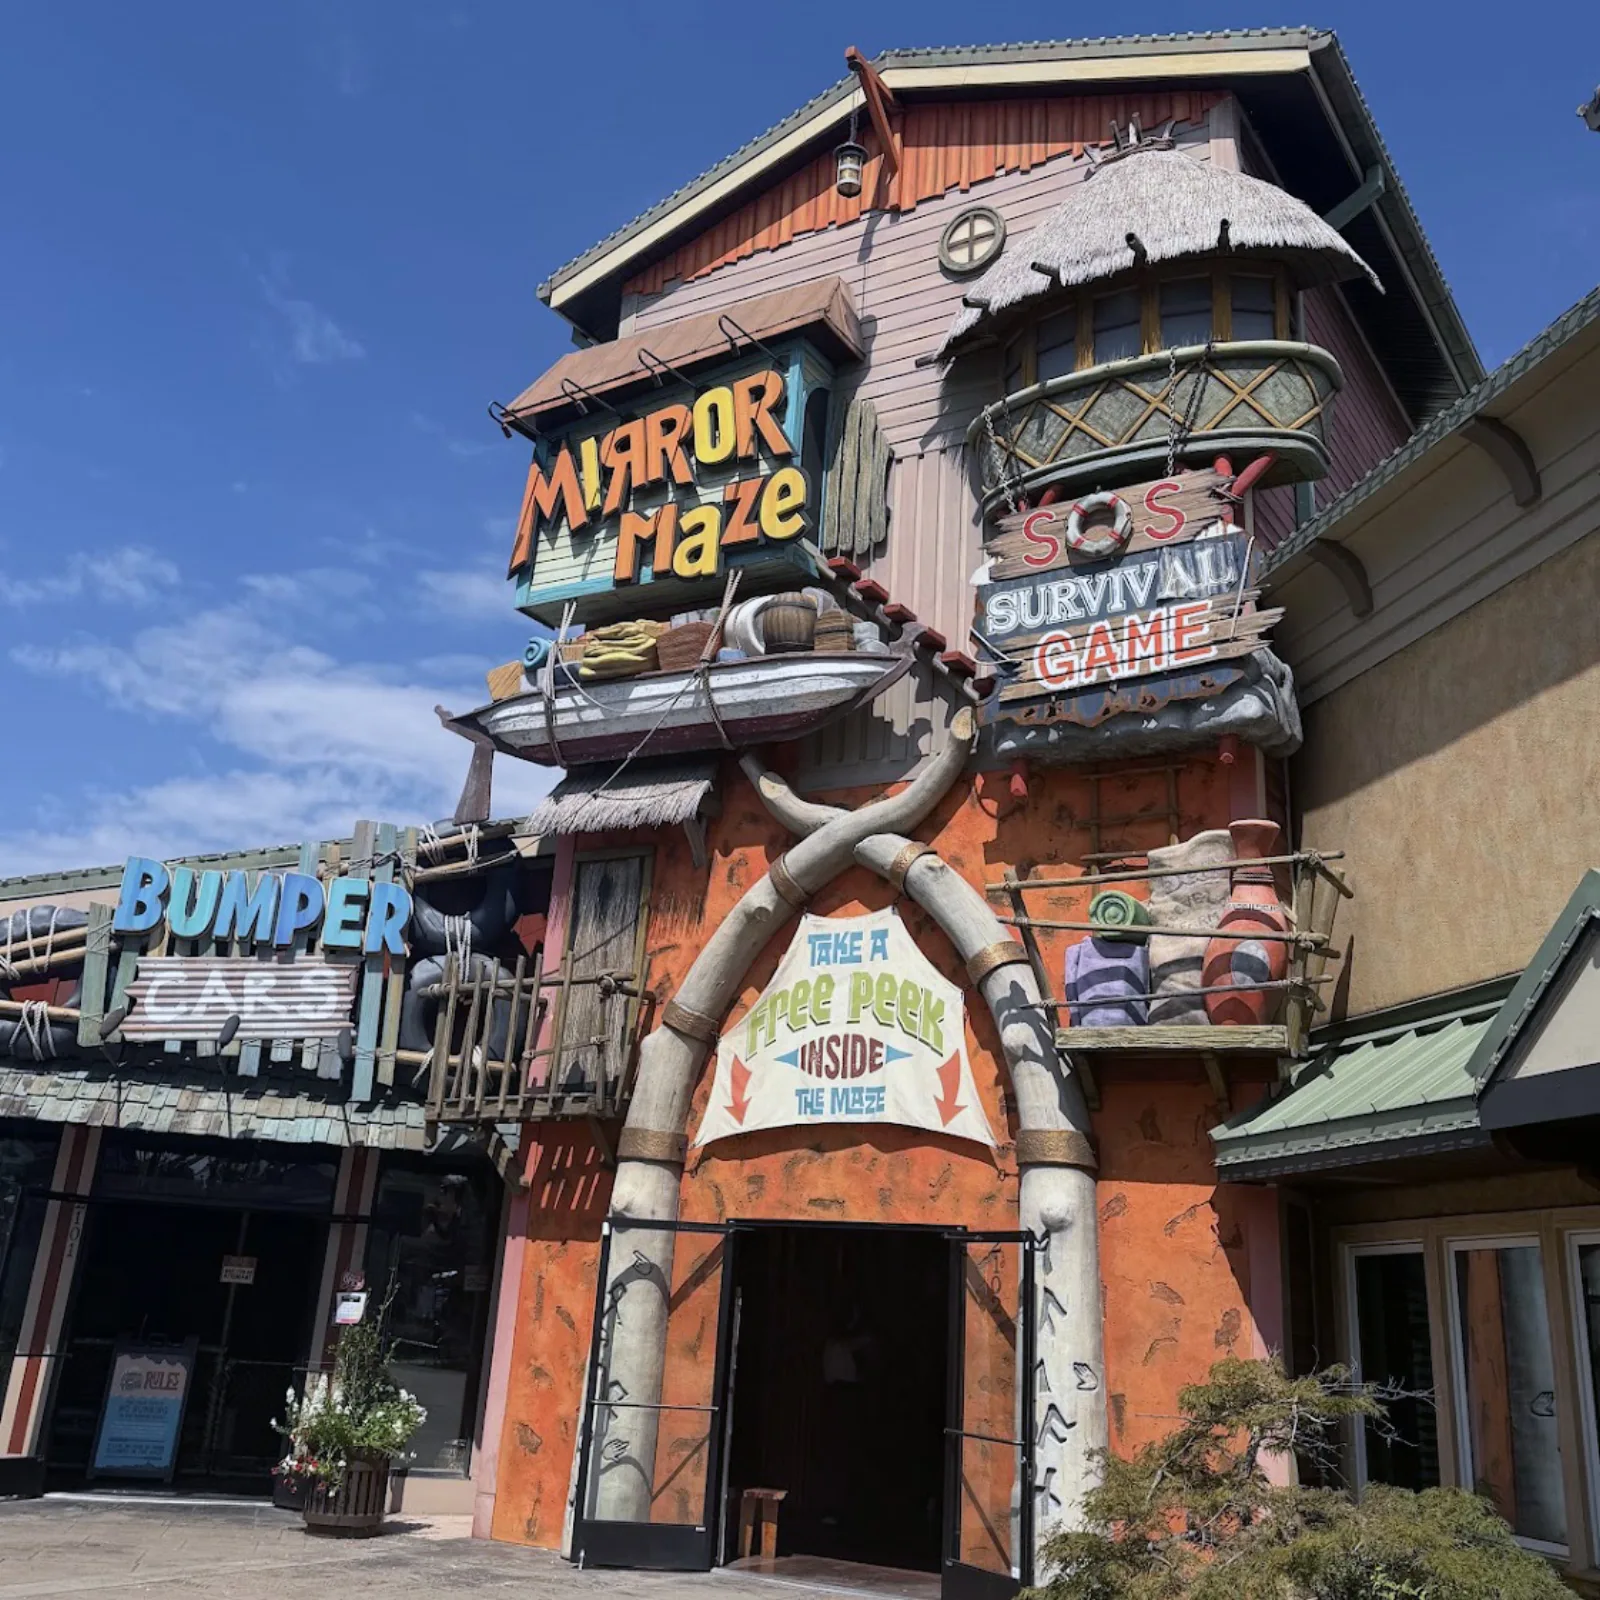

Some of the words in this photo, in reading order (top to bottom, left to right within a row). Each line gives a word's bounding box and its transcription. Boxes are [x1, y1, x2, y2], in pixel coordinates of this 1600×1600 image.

[509, 369, 796, 576] MIRROR
[985, 541, 1237, 635] SURVIVAL
[1034, 600, 1217, 690] GAME
[111, 856, 414, 956] BUMPER
[807, 930, 864, 967] TAKE
[869, 928, 889, 962] A
[143, 968, 341, 1022] CARS
[800, 1033, 885, 1080] INSIDE
[795, 1087, 825, 1116] THE
[830, 1086, 886, 1116] MAZE
[143, 1371, 180, 1390] RULES
